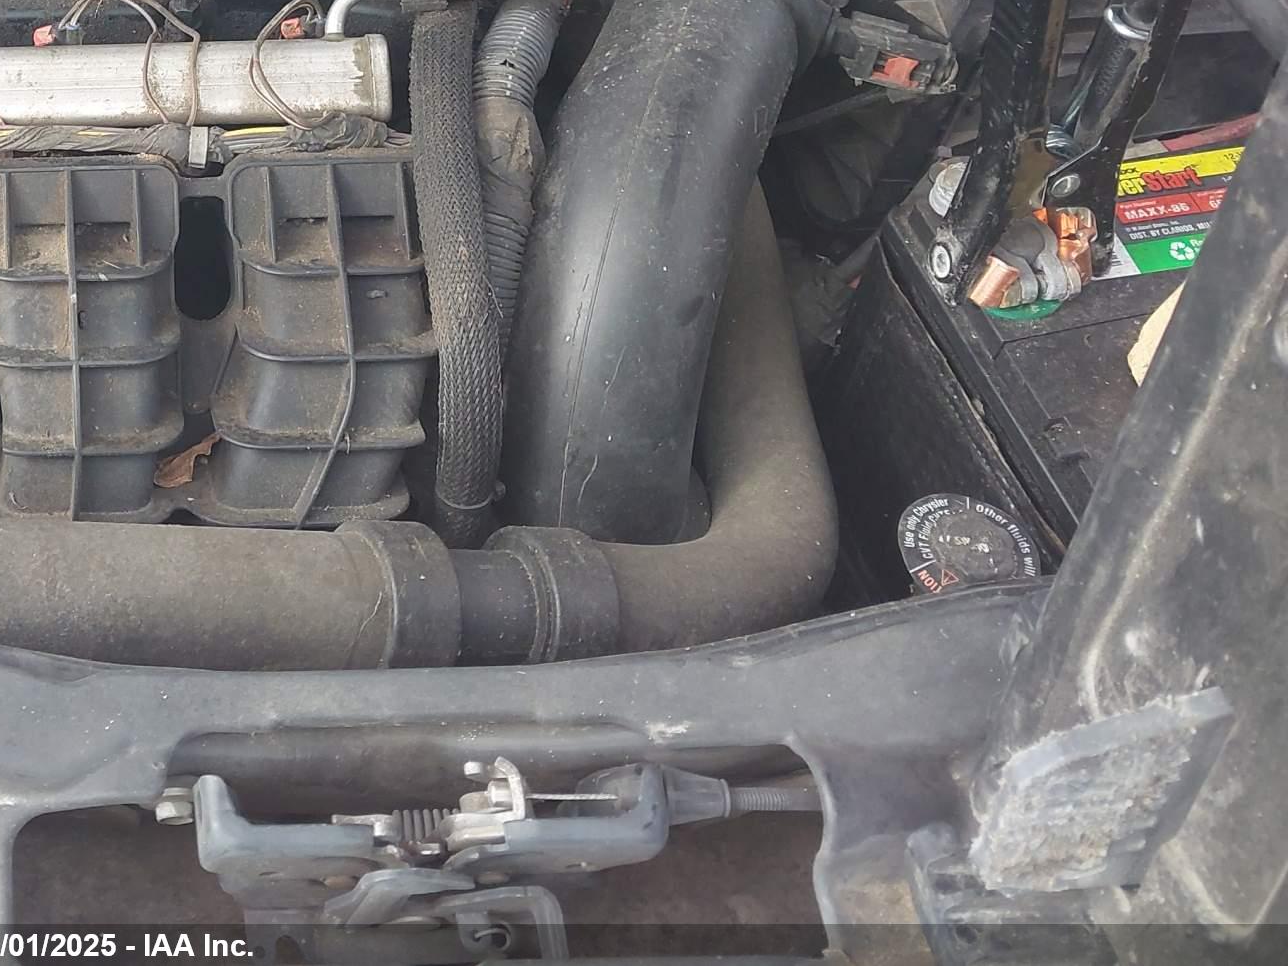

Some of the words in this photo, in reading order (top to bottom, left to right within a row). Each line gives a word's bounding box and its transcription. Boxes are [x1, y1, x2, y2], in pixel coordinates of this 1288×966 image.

[1129, 230, 1151, 241] DIST.
[1150, 228, 1161, 238] BY
[912, 497, 949, 517] Chrysler
[907, 514, 921, 532] only
[904, 532, 915, 548] Use
[918, 540, 934, 560] CVT
[975, 504, 1009, 526] Other
[1006, 523, 1031, 555] fluids
[1023, 556, 1037, 578] will
[917, 569, 943, 594] TION
